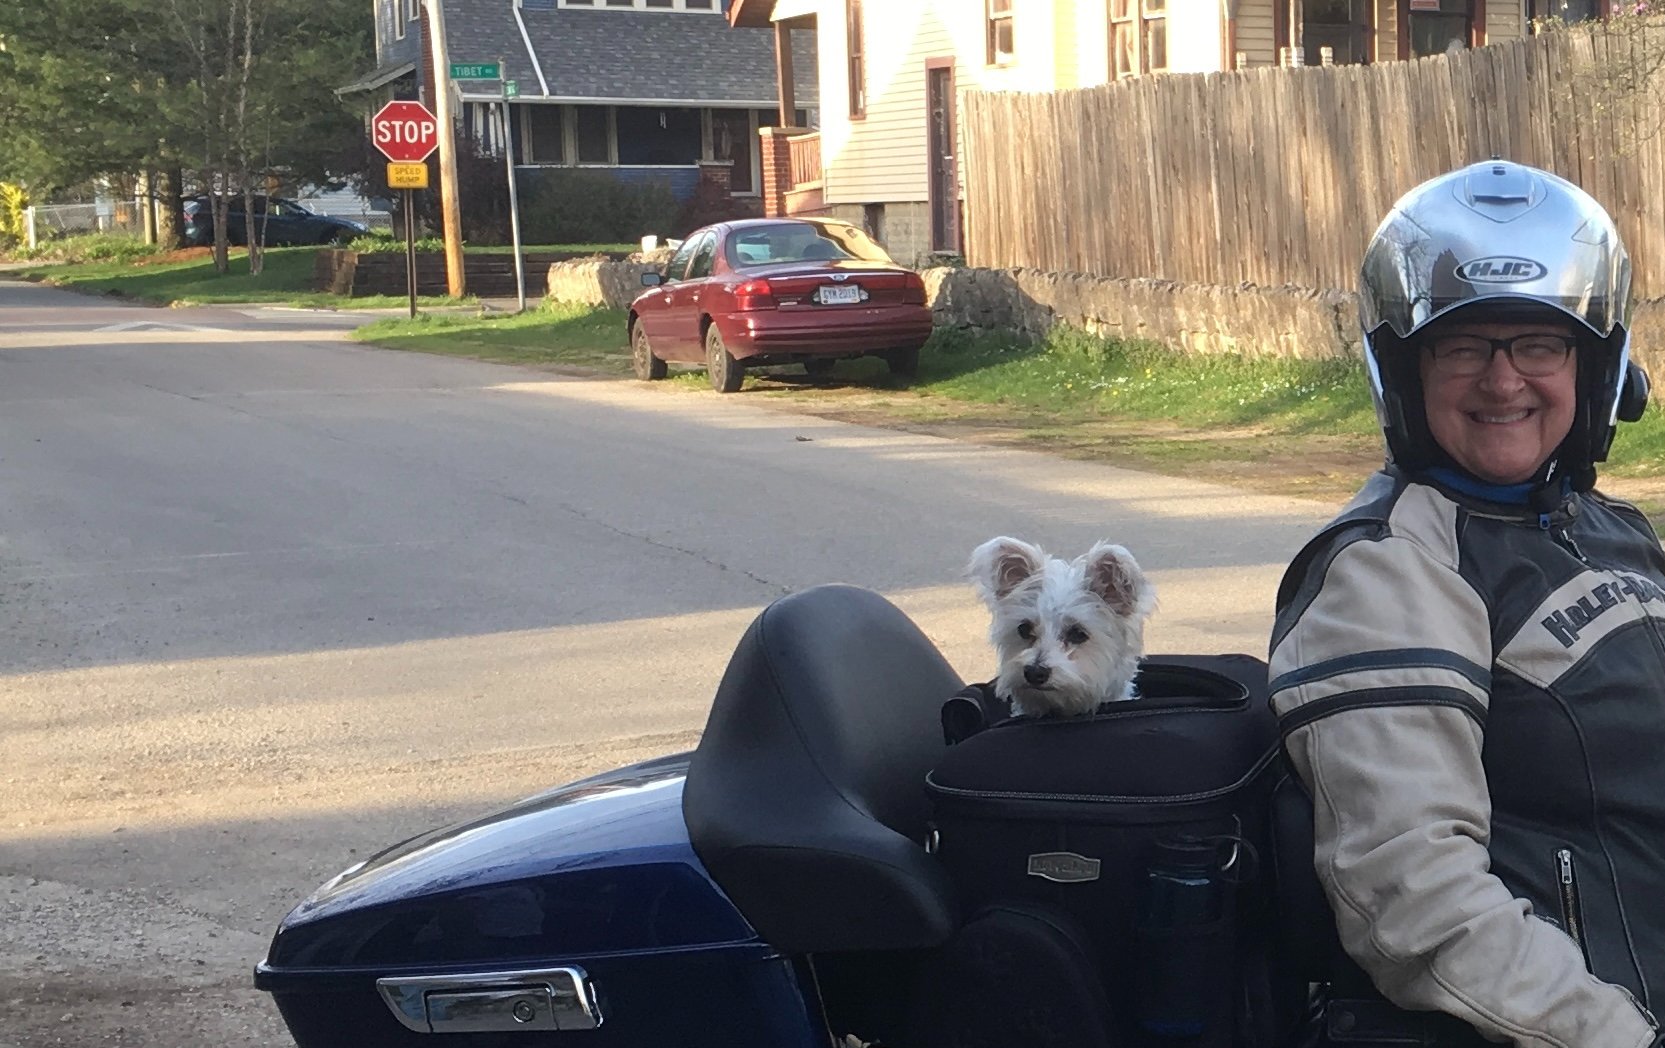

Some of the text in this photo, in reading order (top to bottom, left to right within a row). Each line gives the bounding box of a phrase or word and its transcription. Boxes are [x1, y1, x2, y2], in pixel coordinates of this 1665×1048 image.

[455, 66, 483, 76] TIBET
[377, 120, 435, 144] STOP
[394, 167, 422, 175] SPEED
[1468, 262, 1534, 277] HJC
